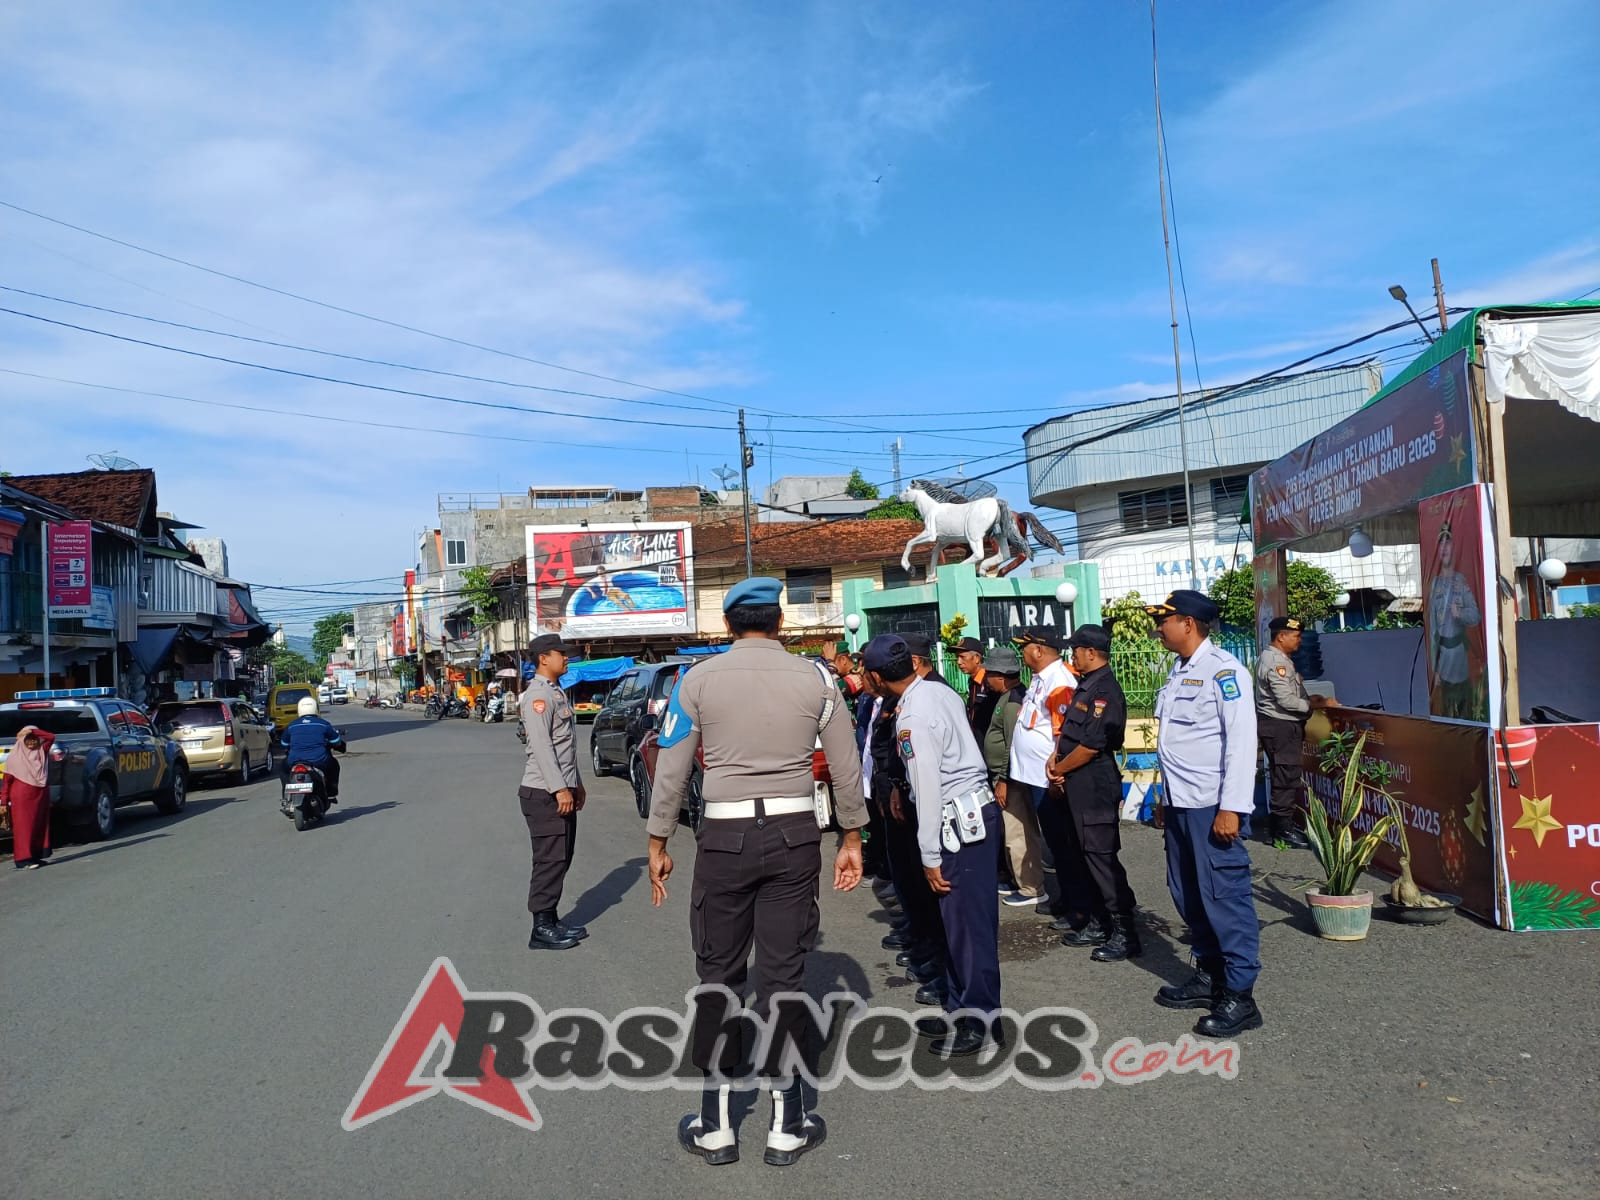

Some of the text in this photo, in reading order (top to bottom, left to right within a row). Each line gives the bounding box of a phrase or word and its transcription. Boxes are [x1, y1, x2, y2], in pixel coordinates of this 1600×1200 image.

[1344, 424, 1394, 468] PELAYANAN
[1314, 477, 1333, 503] 2025
[1333, 469, 1350, 496] DAN
[1350, 456, 1379, 487] TAHUN
[1380, 443, 1406, 475] BARU
[1408, 430, 1437, 464] 2026
[1308, 486, 1362, 526] POLRES DOMPU
[608, 531, 678, 556] AIRPLANE
[641, 549, 678, 565] MODE
[660, 566, 675, 576] WHY
[118, 751, 151, 773] POLISI
[1410, 804, 1441, 836] 2025
